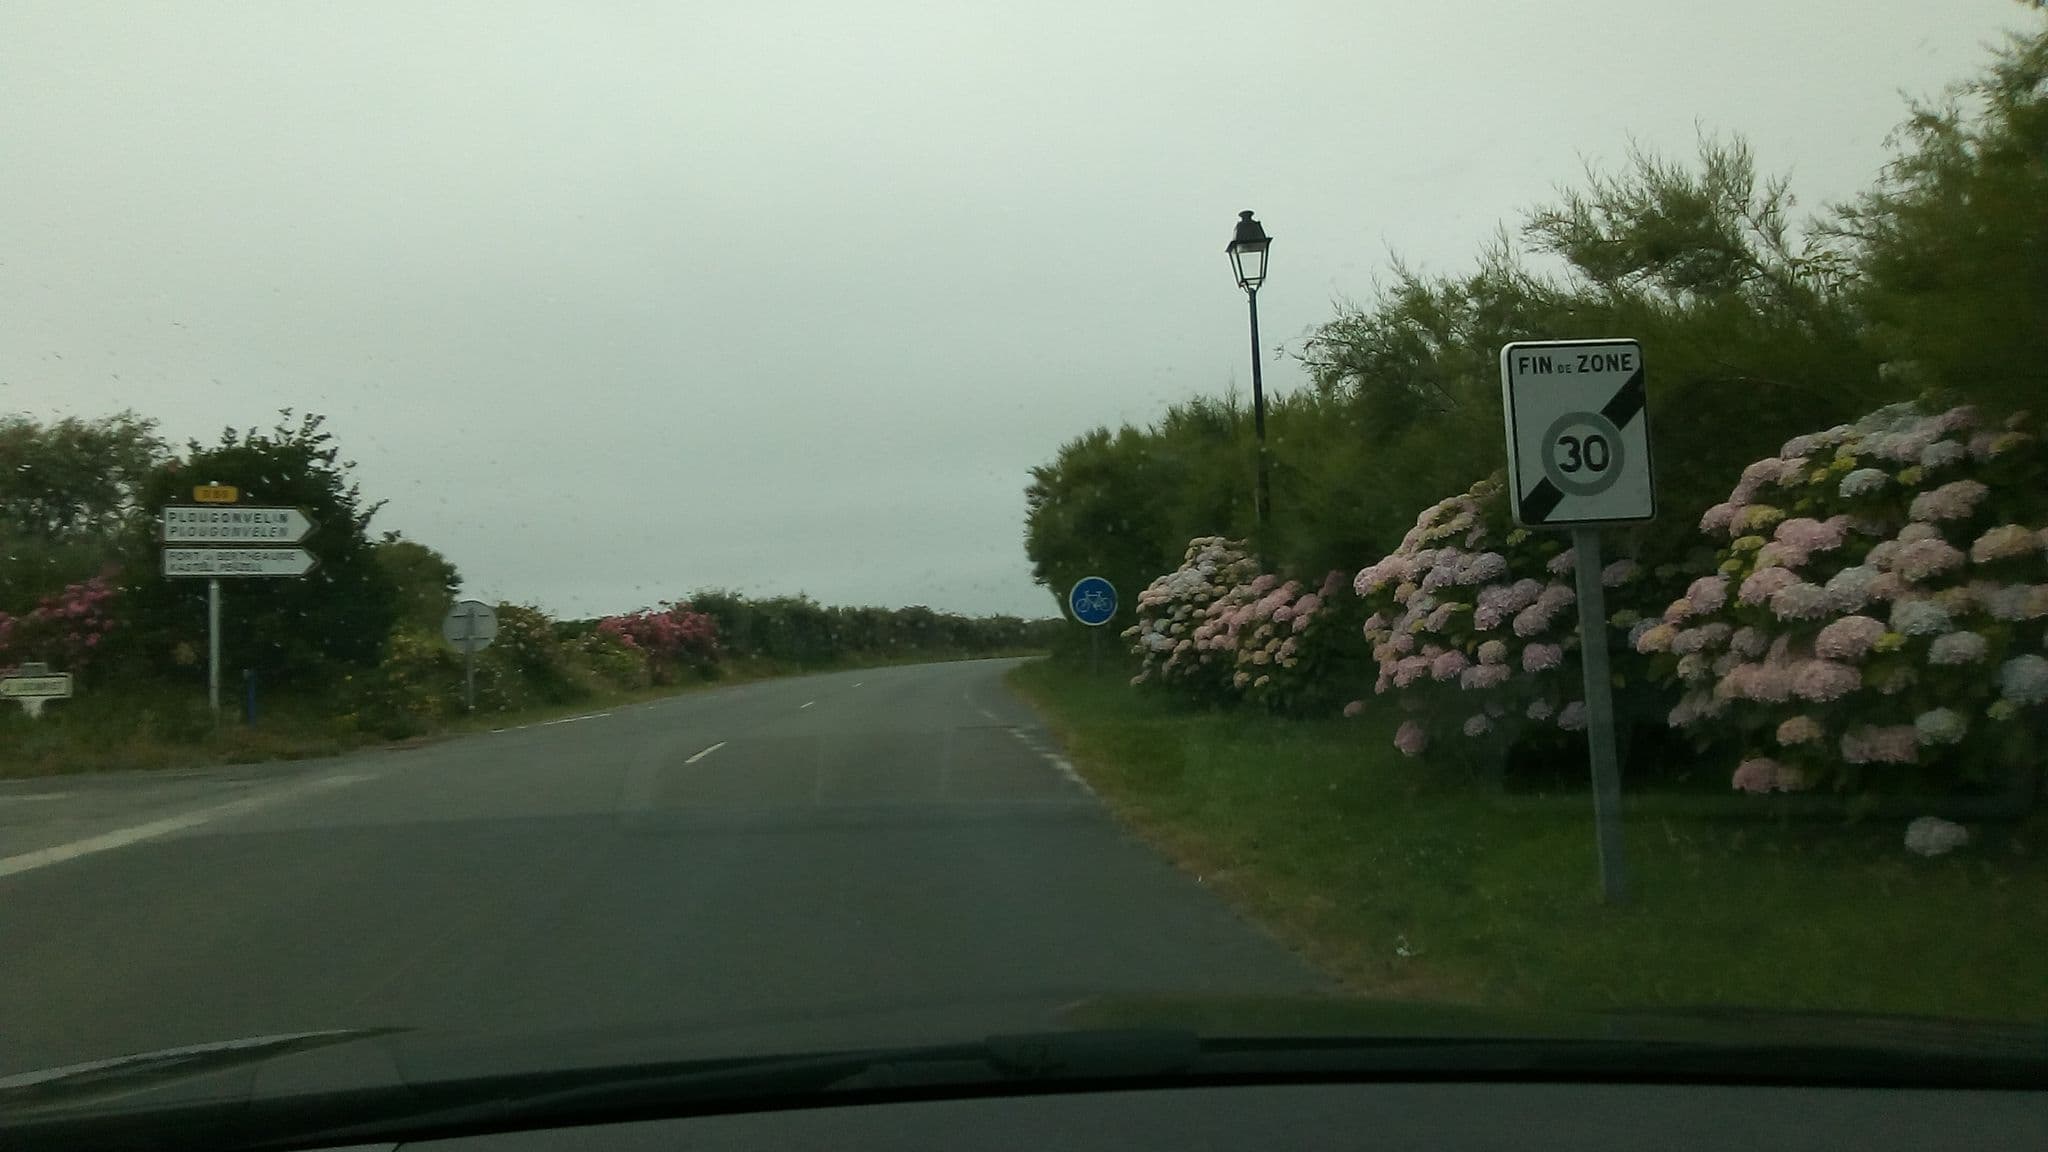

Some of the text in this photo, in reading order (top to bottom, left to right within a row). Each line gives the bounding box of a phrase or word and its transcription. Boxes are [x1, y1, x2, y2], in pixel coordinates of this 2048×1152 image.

[1518, 353, 1633, 375] FIN DE ZONE
[1557, 434, 1610, 473] 30
[168, 511, 288, 524] PLOUGONVELIN
